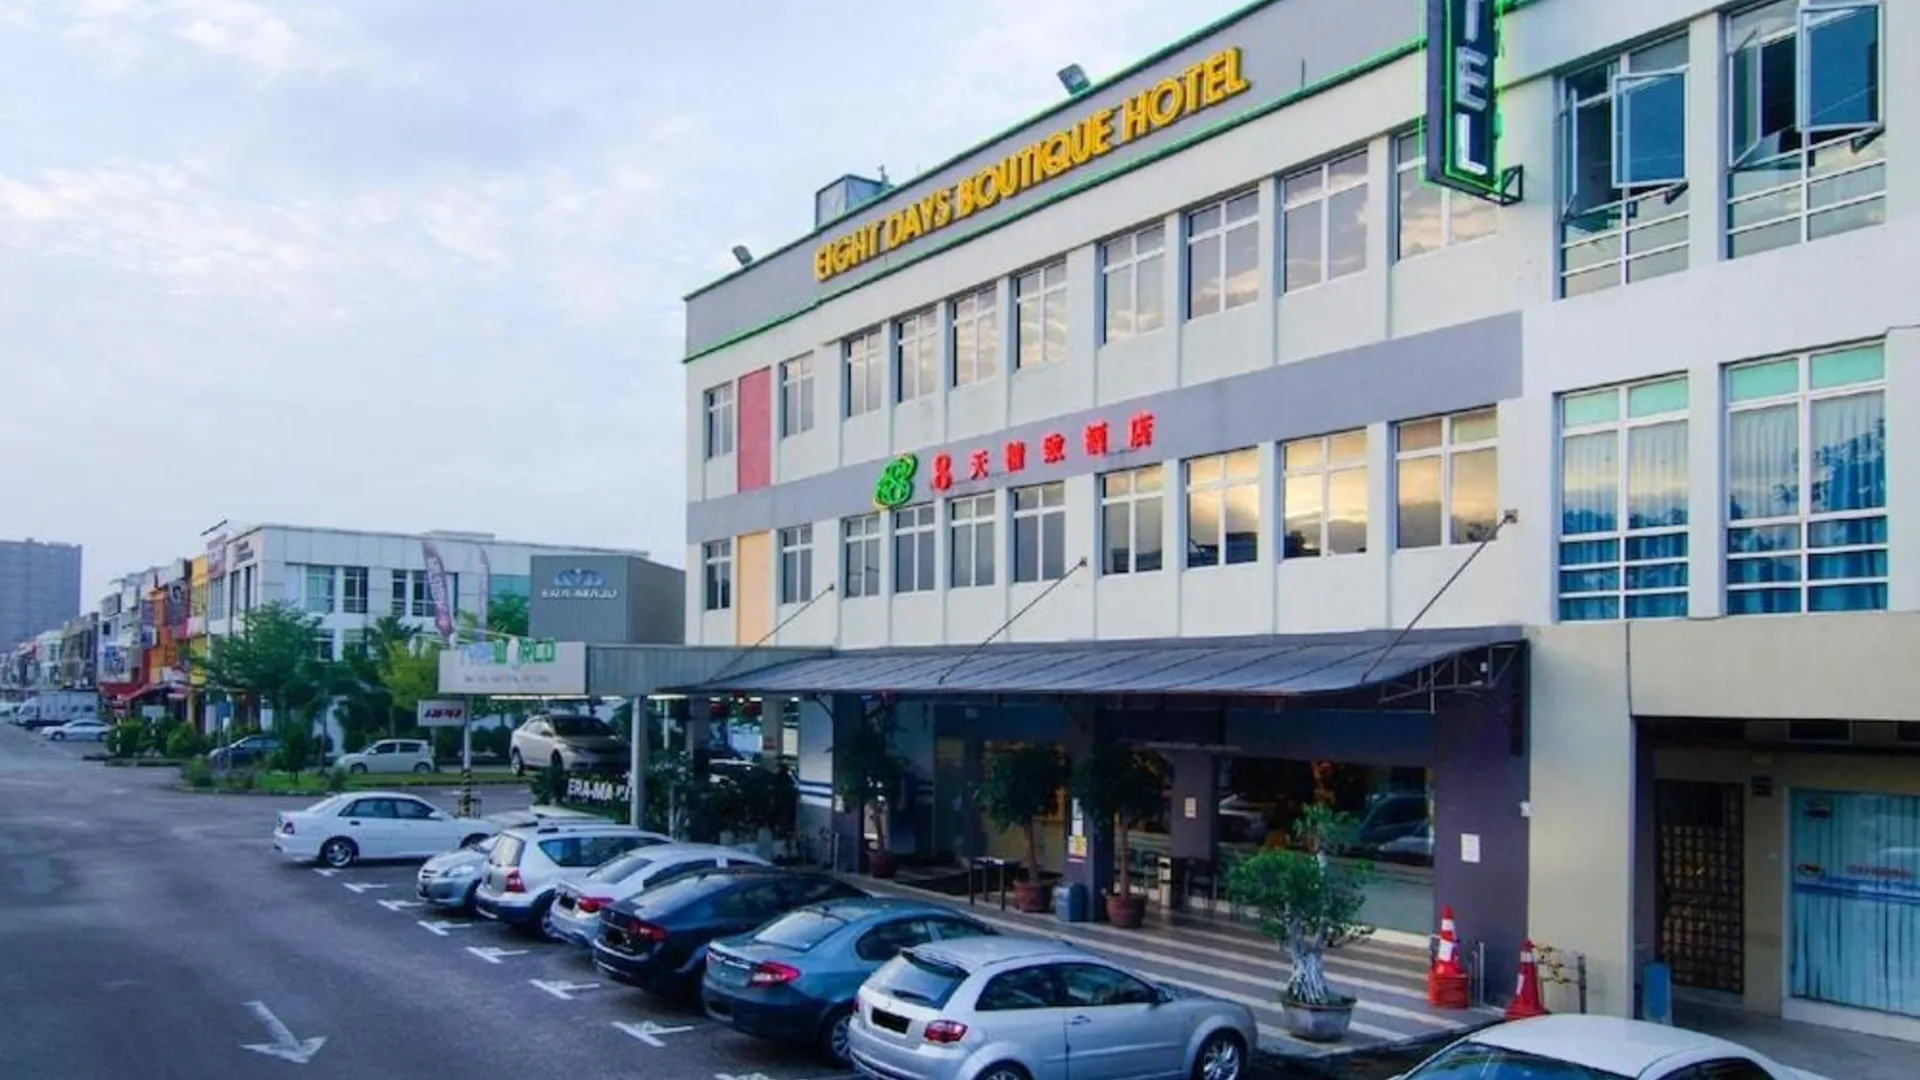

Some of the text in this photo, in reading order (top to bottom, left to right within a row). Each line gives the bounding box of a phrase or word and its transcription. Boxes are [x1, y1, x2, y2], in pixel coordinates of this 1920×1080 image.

[813, 47, 1251, 282] EIGHT DAYS BOUTIQUE HOTEL
